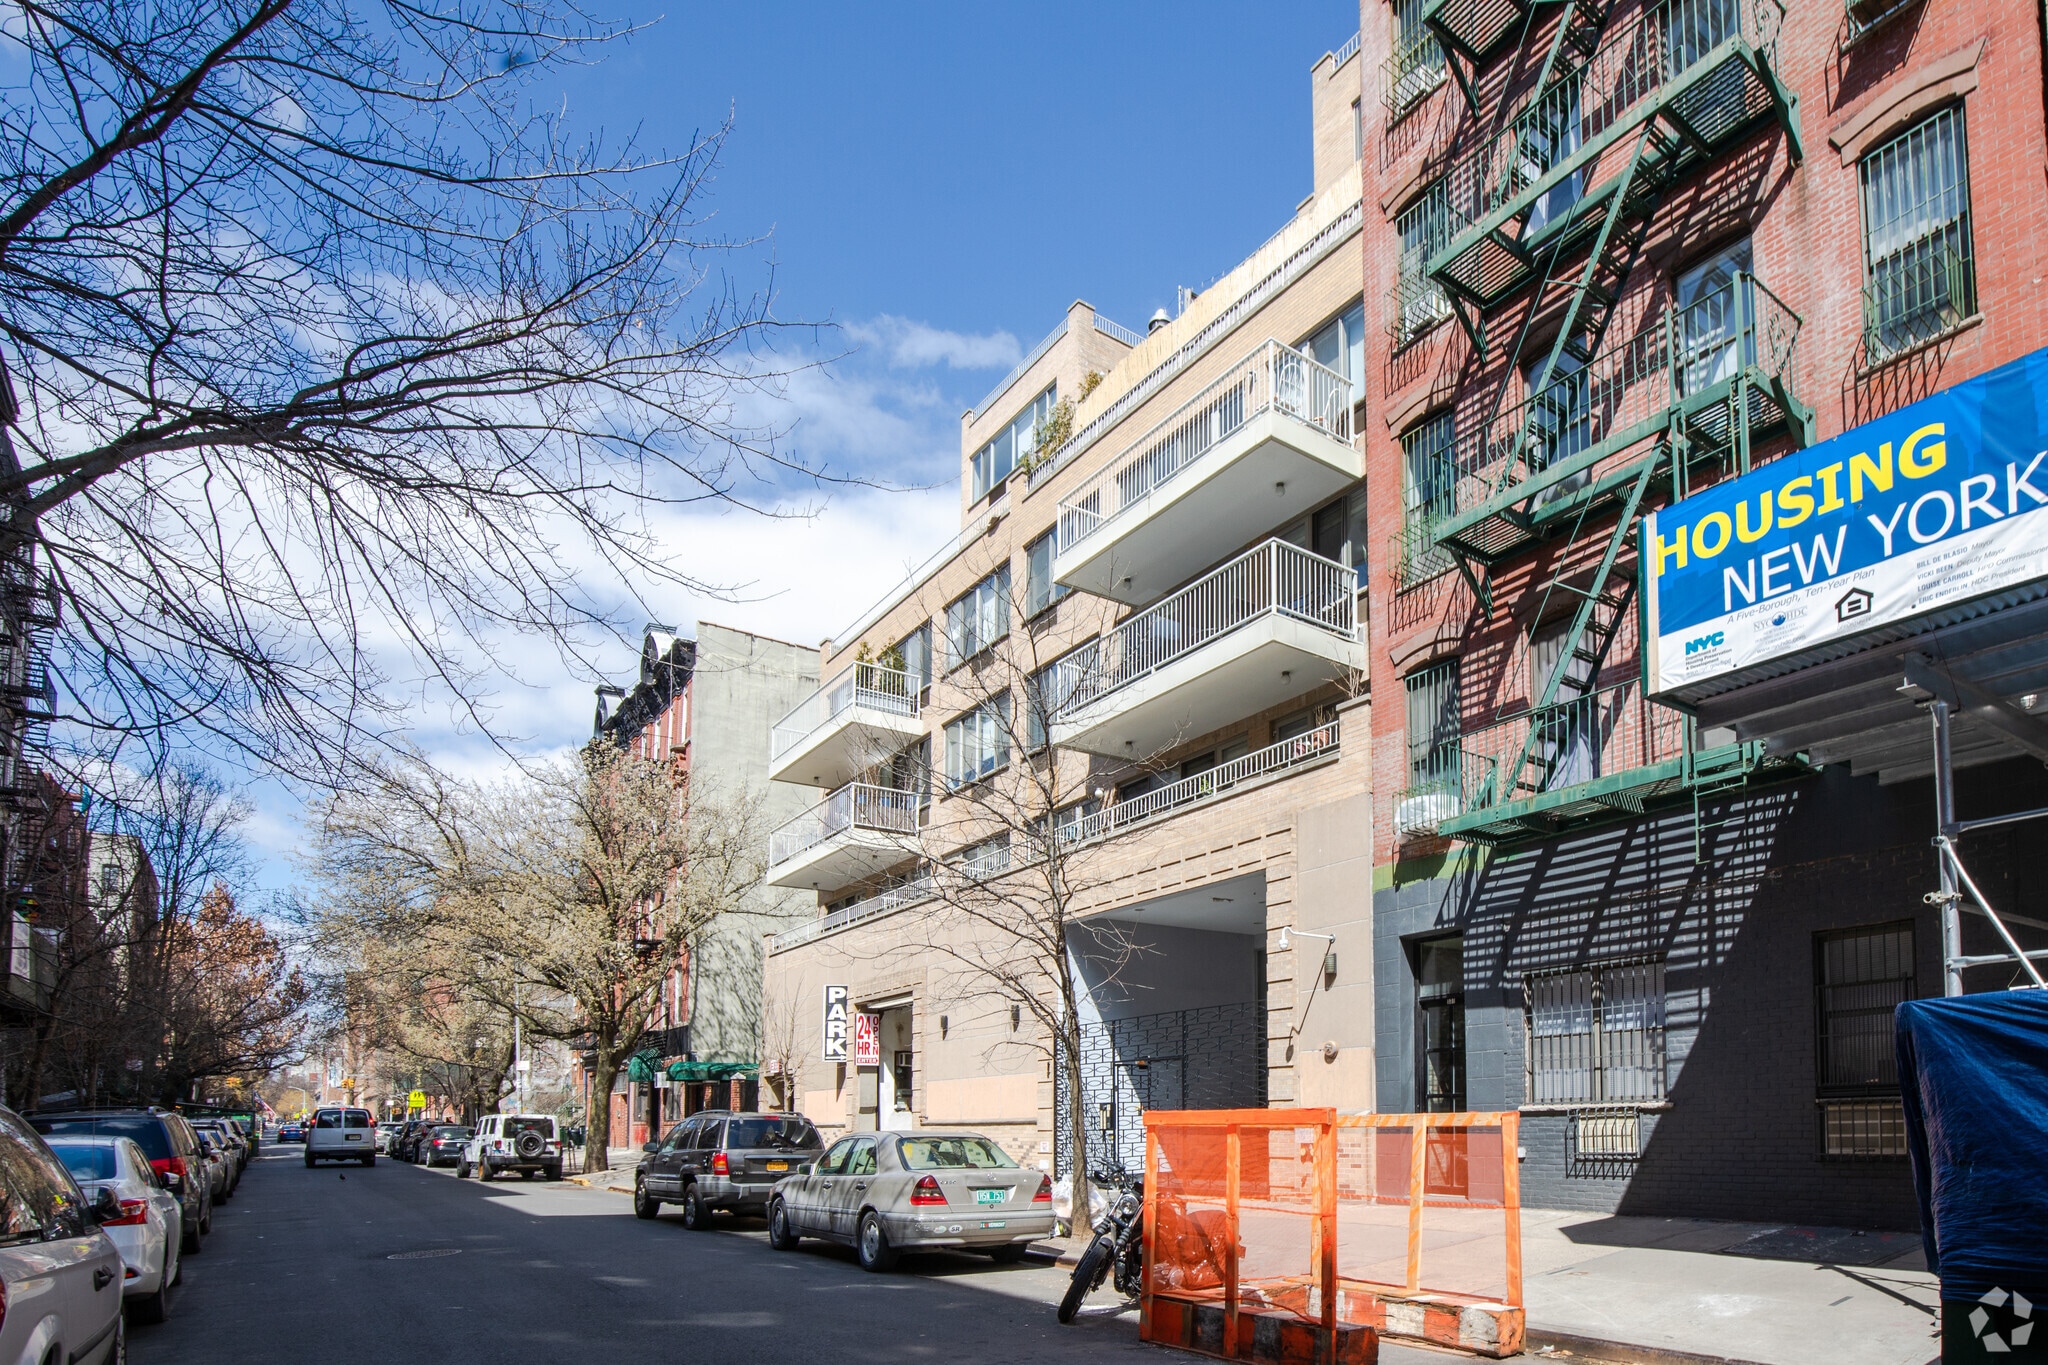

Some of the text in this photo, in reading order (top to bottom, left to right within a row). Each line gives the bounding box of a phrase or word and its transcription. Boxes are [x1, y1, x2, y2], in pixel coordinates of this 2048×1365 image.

[1657, 423, 1945, 577] HOUSING
[1723, 449, 2048, 612] NEW YORK
[1917, 539, 1994, 569] BILL DE BLASIO Mayor
[1917, 547, 2006, 580] VICKI BEEN Deputy Mayor
[1727, 568, 1875, 624] A Five-Borough, Ten-Year Plan
[1917, 580, 1943, 593] LOUISE
[1943, 570, 1973, 584] CARROLL
[1919, 595, 1934, 604] ERIC
[1991, 565, 2026, 580] President
[1685, 631, 1724, 655] NYC
[826, 986, 847, 1055] PARK
[857, 1015, 871, 1040] 24
[857, 1041, 870, 1055] HR
